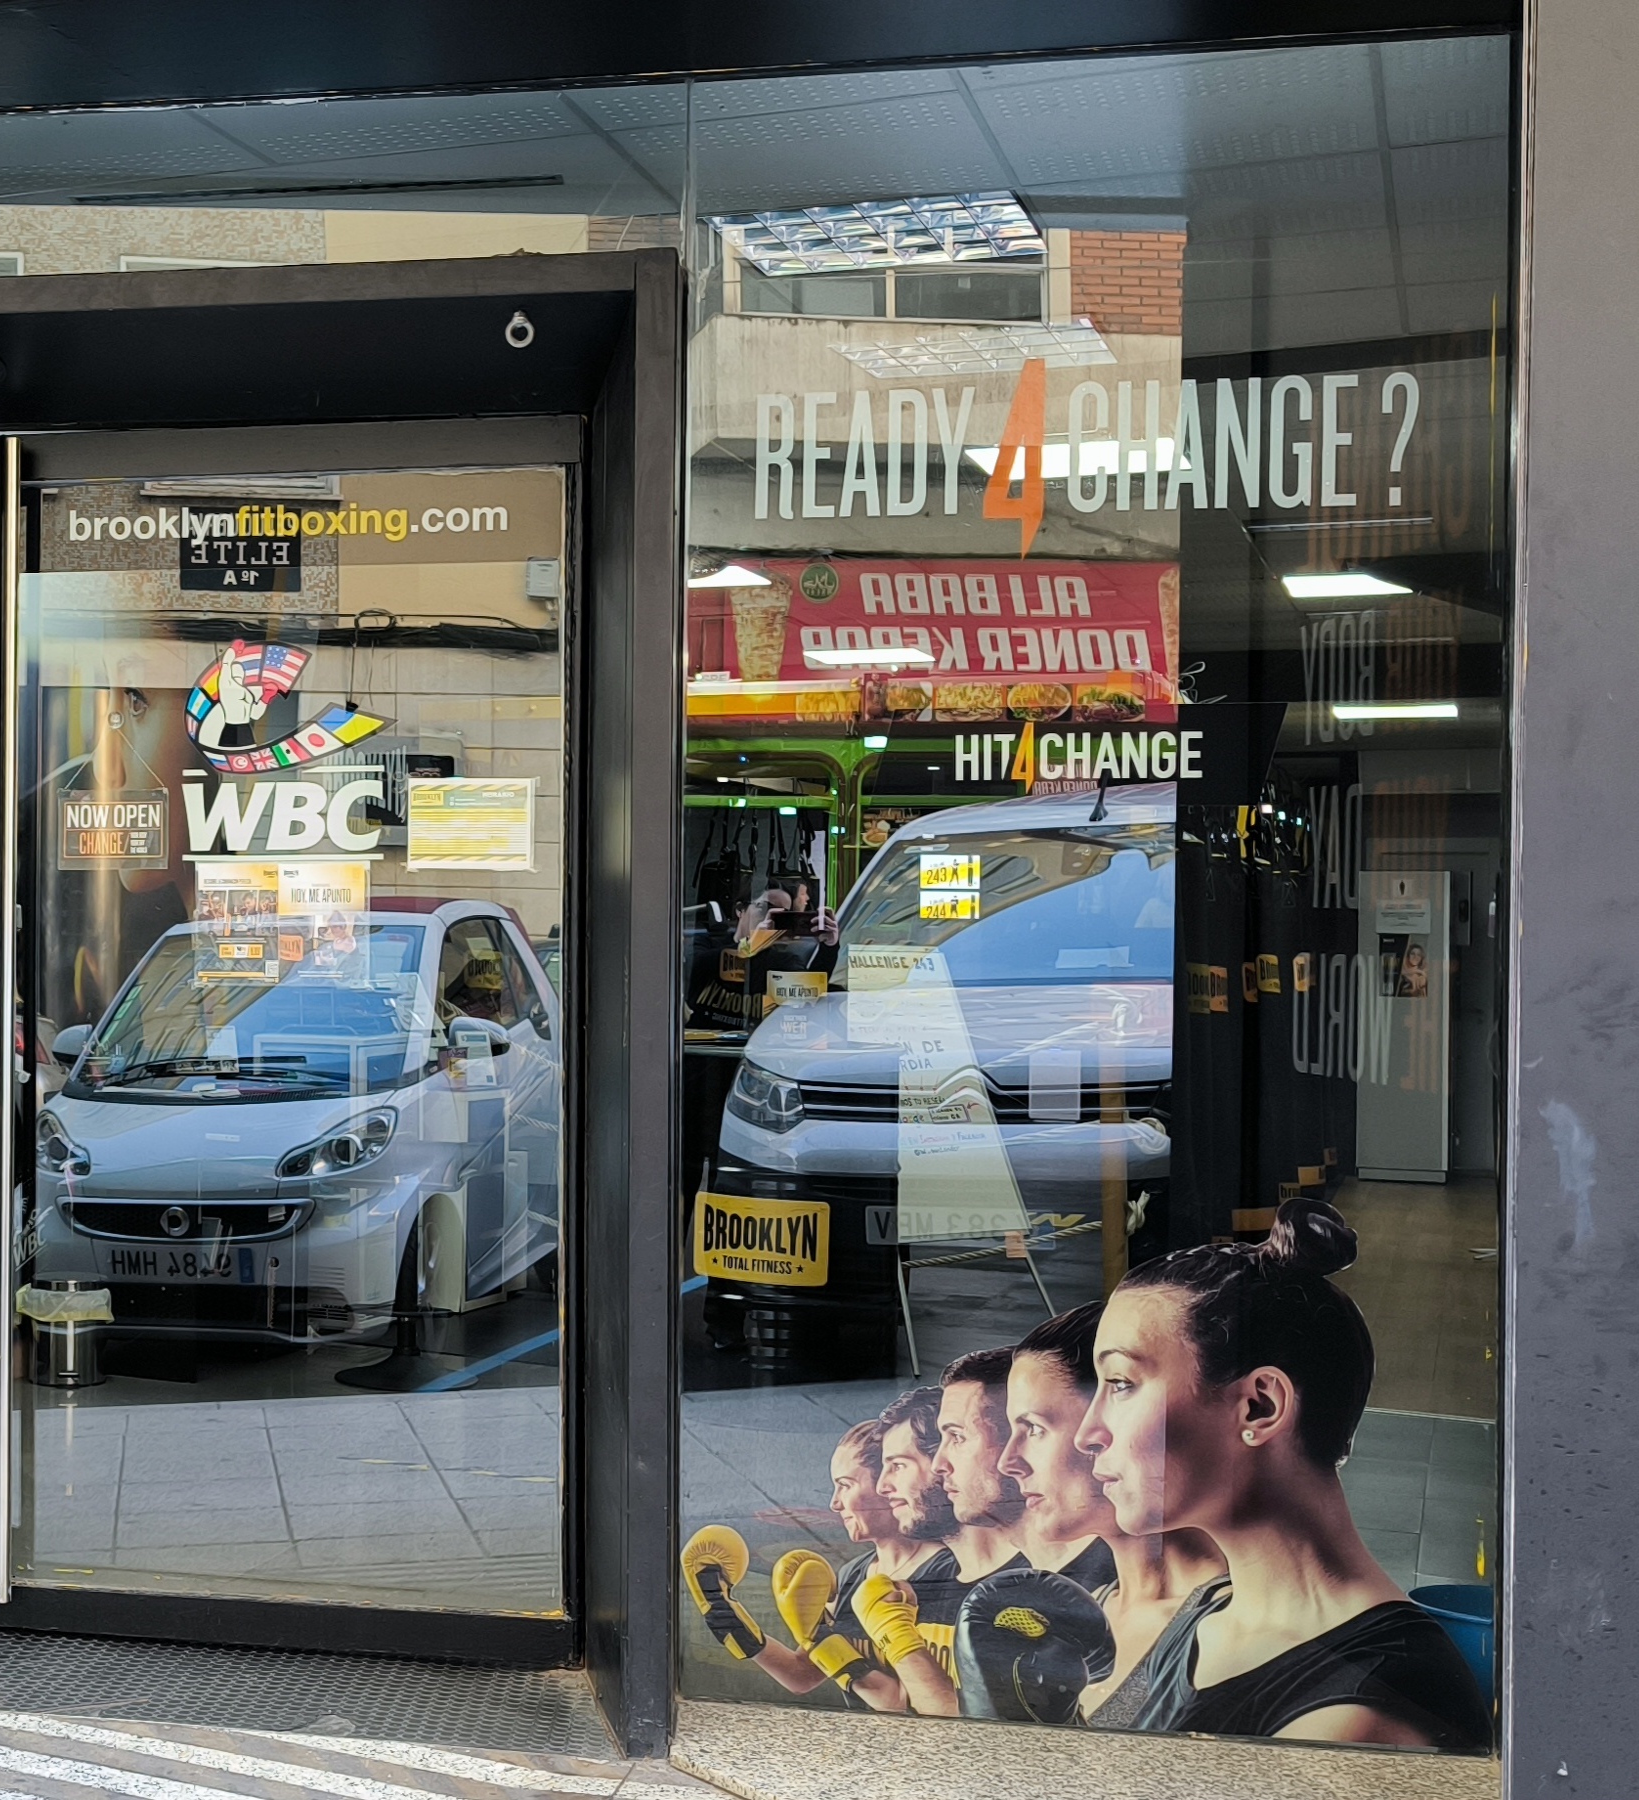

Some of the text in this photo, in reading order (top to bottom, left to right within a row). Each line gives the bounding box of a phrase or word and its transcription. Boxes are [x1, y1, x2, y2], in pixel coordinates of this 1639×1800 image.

[754, 357, 1421, 560] READY 4 CHANGE ?
[68, 503, 509, 546] brooklynfitboxing.com
[954, 721, 1204, 794] HIT4CHANGE
[66, 804, 161, 828] NOW OPEN
[182, 779, 385, 854] WBC
[79, 831, 124, 855] CHANGE
[926, 867, 947, 885] 243
[308, 888, 321, 903] ME
[322, 888, 352, 903] APUNTO
[848, 955, 910, 969] HALLENGE
[703, 1203, 818, 1263] BROOKLYN
[722, 1254, 793, 1275] TOTAL FITNESS
